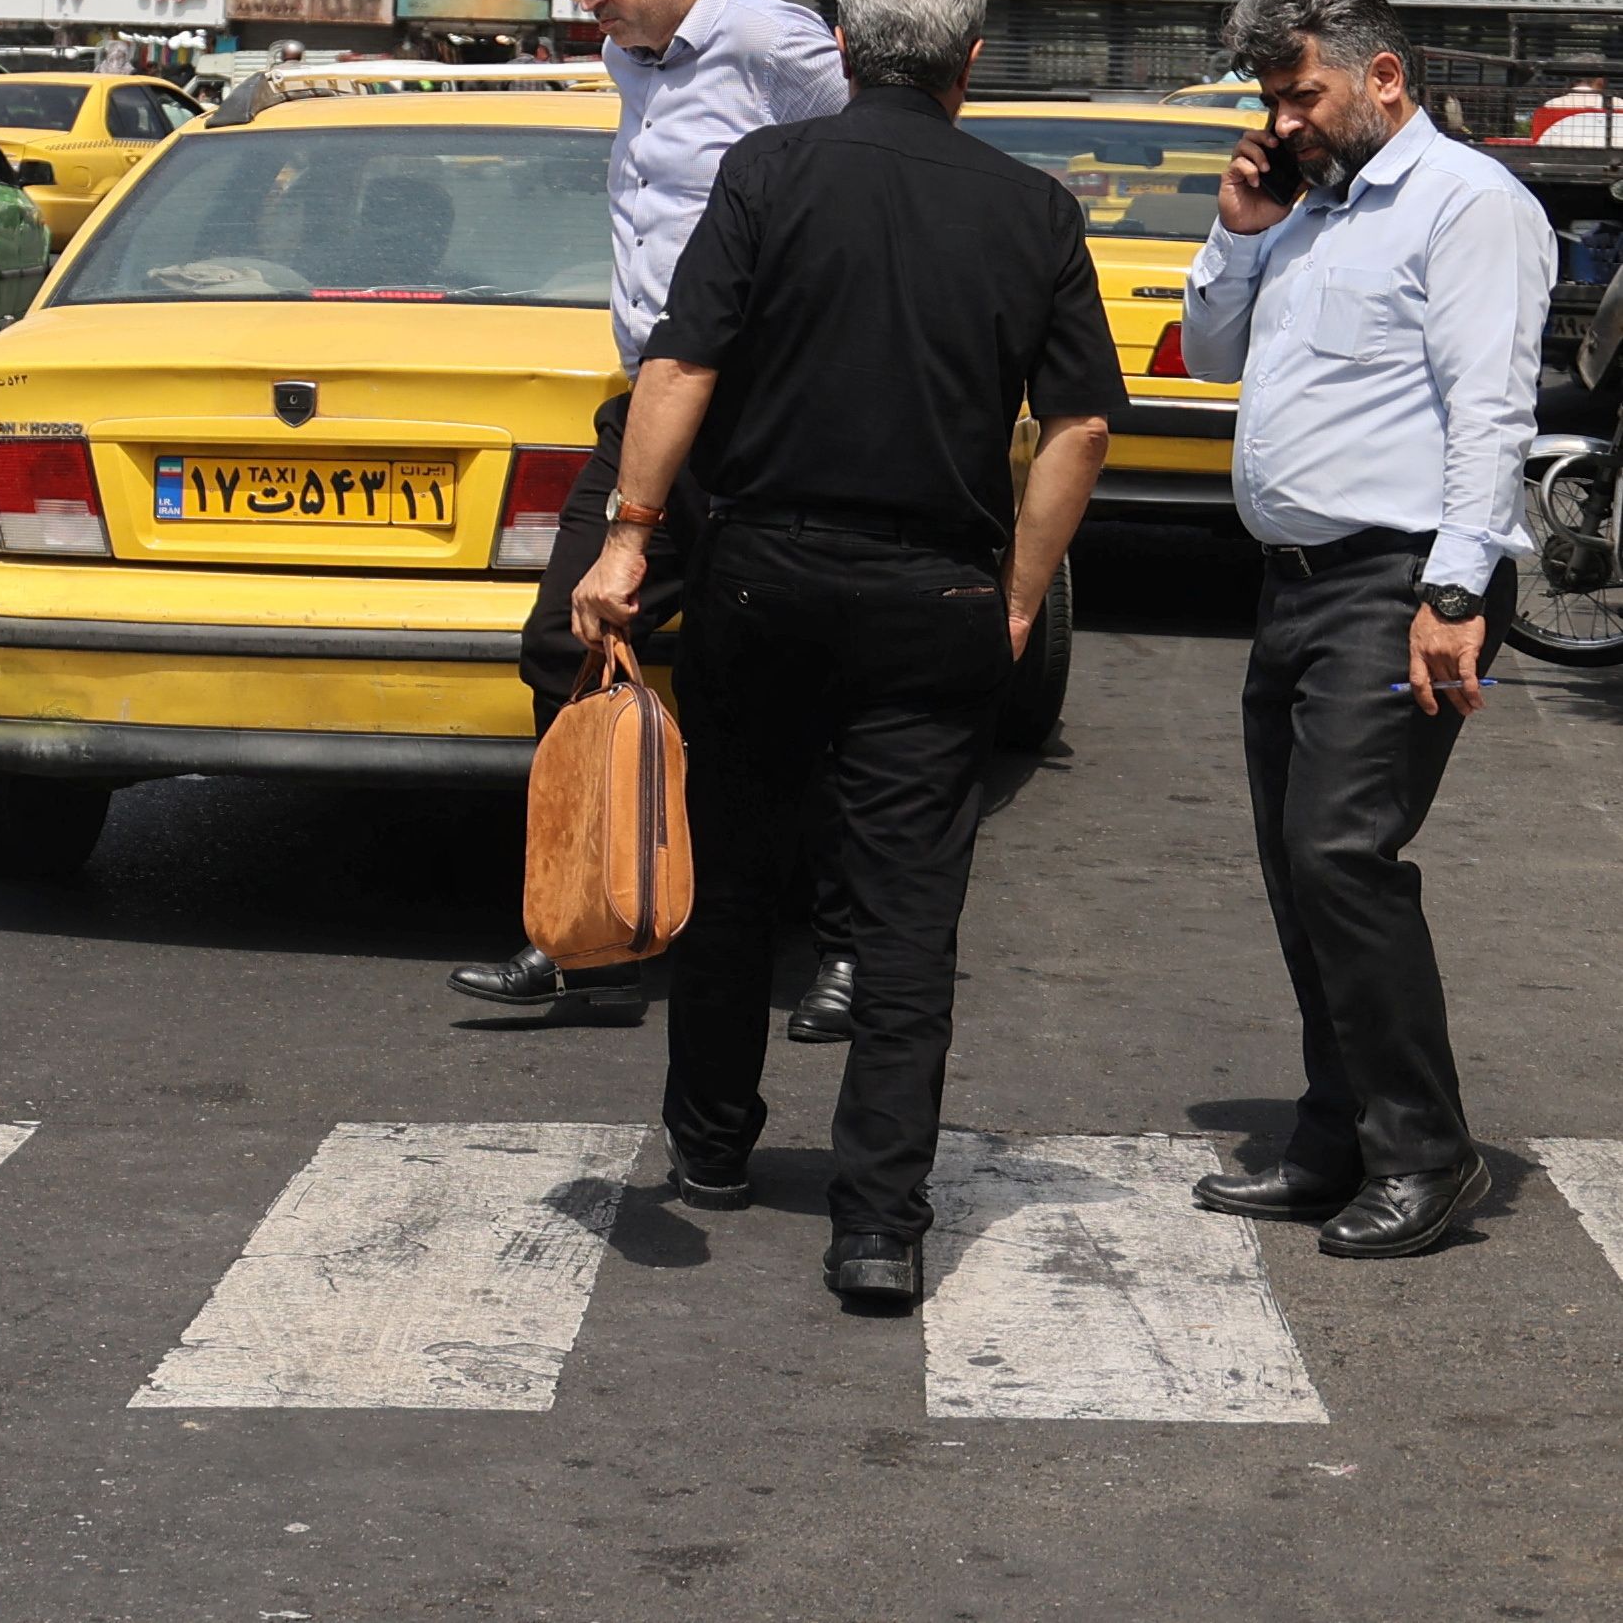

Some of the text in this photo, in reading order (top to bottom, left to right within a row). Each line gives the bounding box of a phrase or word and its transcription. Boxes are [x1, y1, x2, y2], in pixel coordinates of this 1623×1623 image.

[19, 422, 84, 435] KHODRO
[247, 466, 296, 483] TAXI
[400, 464, 446, 477] ایران
[400, 478, 445, 521] ۱۱
[158, 506, 181, 516] IRAN
